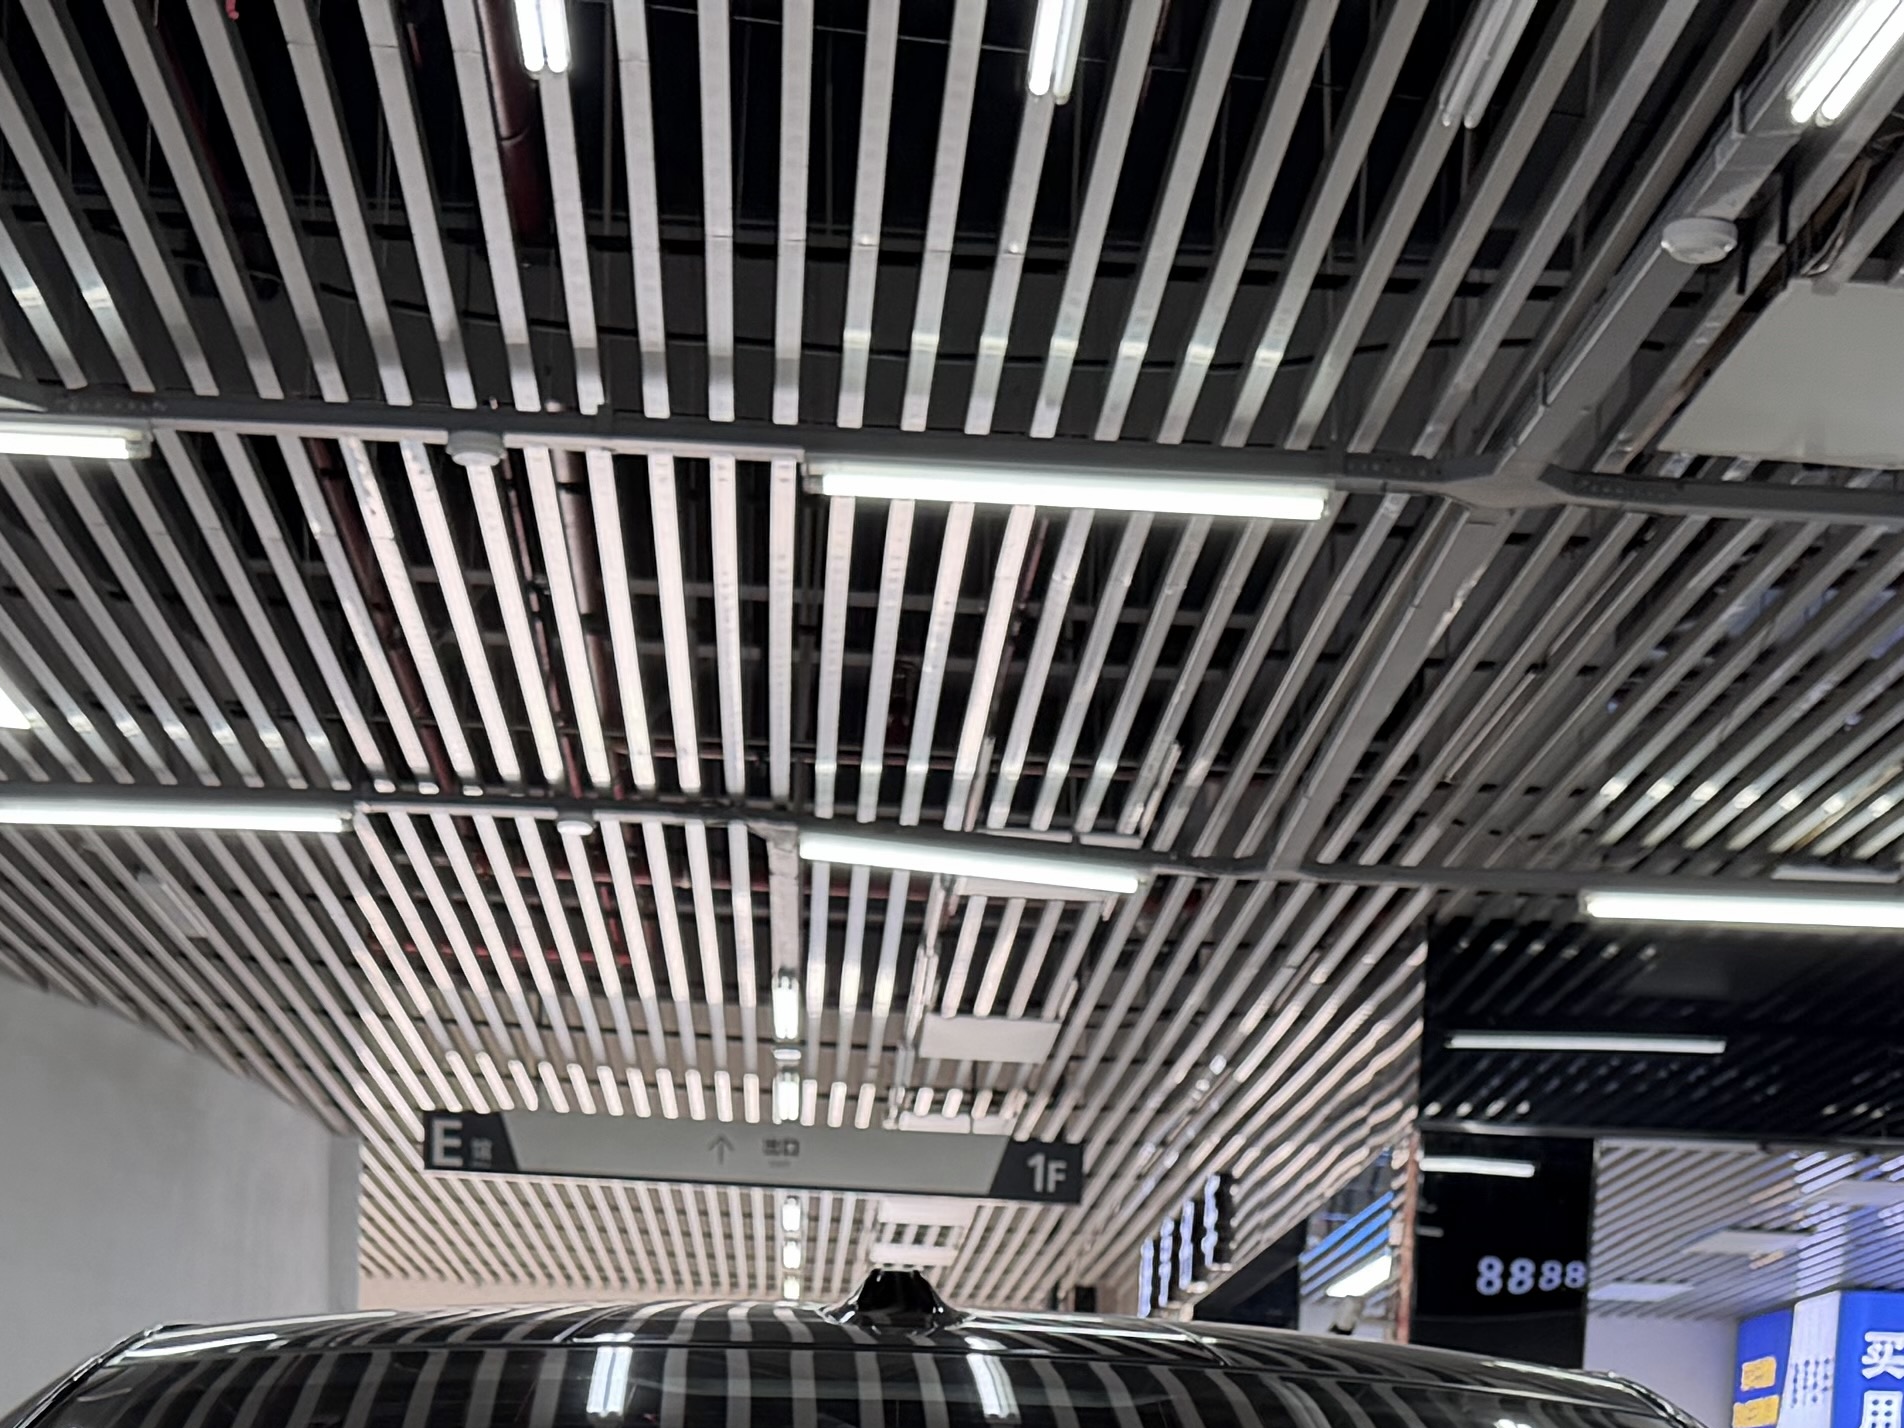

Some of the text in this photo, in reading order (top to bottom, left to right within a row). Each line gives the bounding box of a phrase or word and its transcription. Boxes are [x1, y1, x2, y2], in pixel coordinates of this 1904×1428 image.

[431, 1117, 463, 1168] E
[1026, 1152, 1067, 1194] 1F
[1476, 1255, 1587, 1296] 8888
